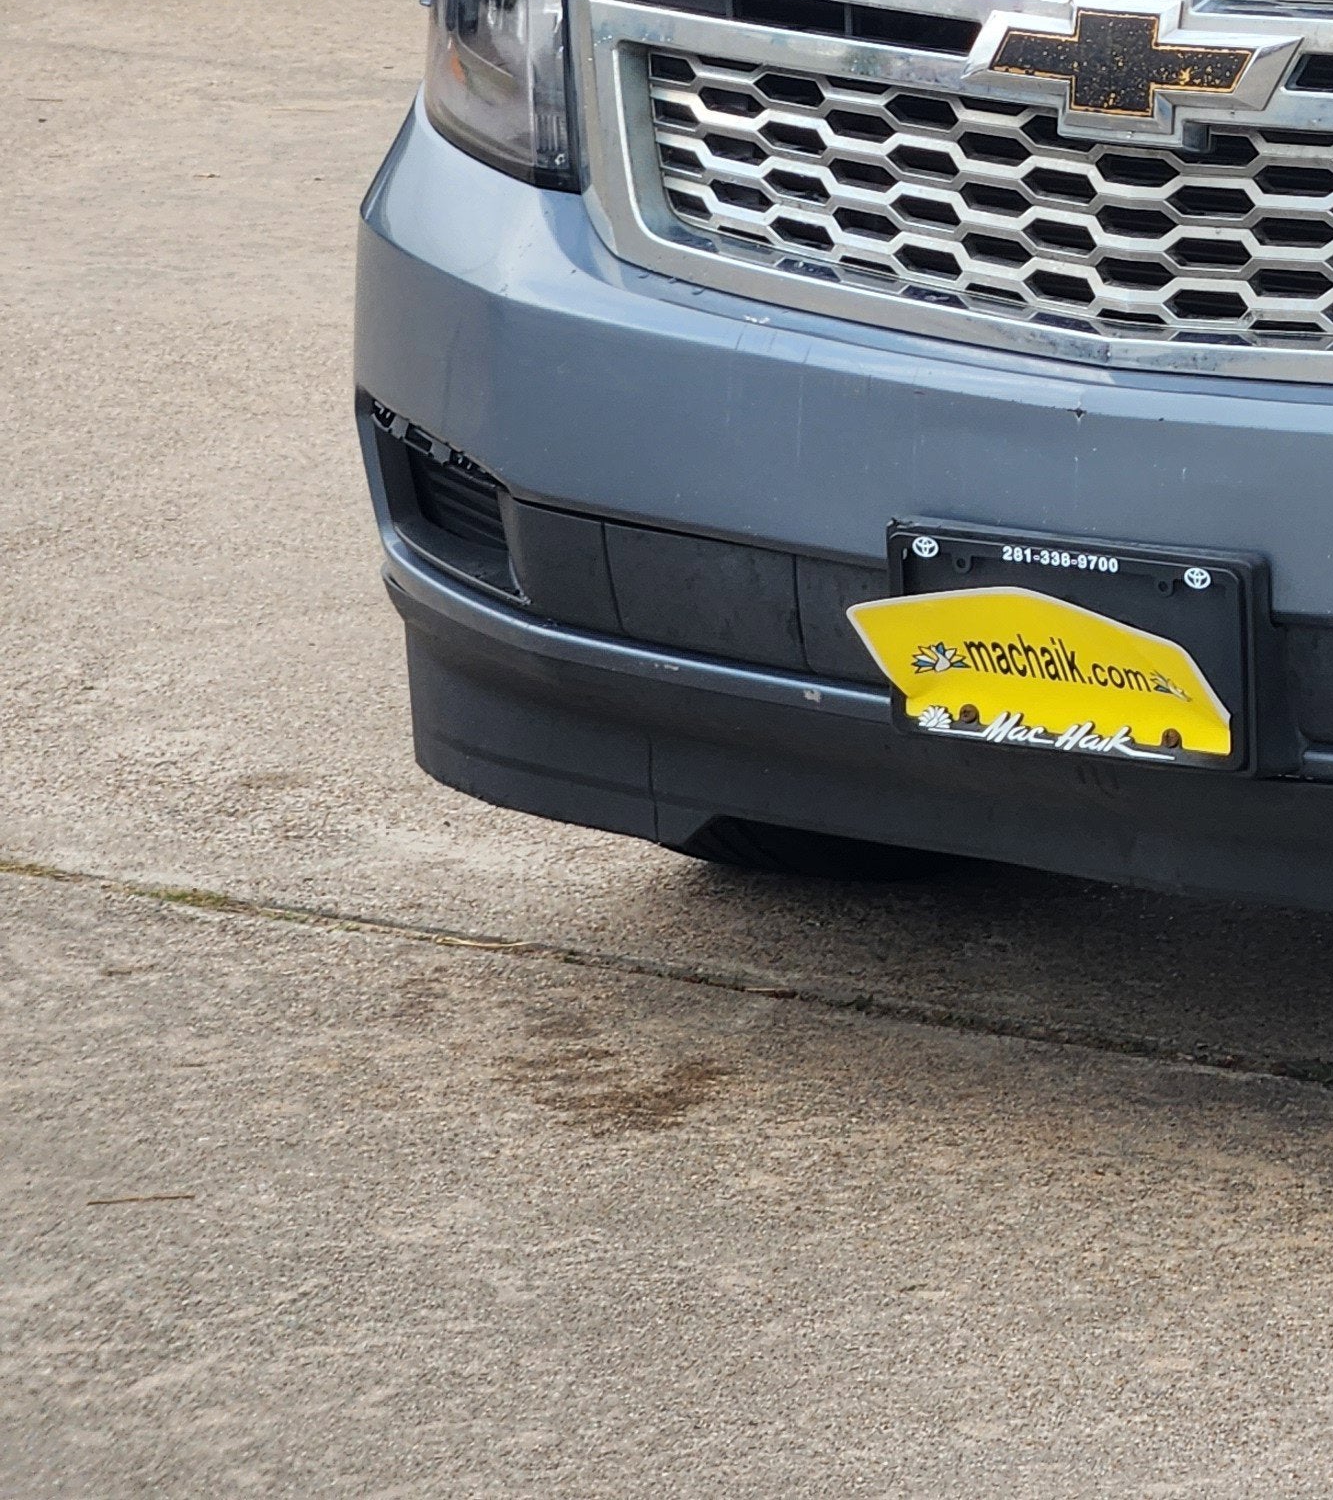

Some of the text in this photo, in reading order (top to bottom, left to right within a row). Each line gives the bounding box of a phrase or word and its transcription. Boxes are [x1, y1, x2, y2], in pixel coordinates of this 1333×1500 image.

[1002, 545, 1120, 574] 281-338-9700
[963, 633, 1152, 693] machaik.com
[983, 710, 1150, 755] Mac Haik
